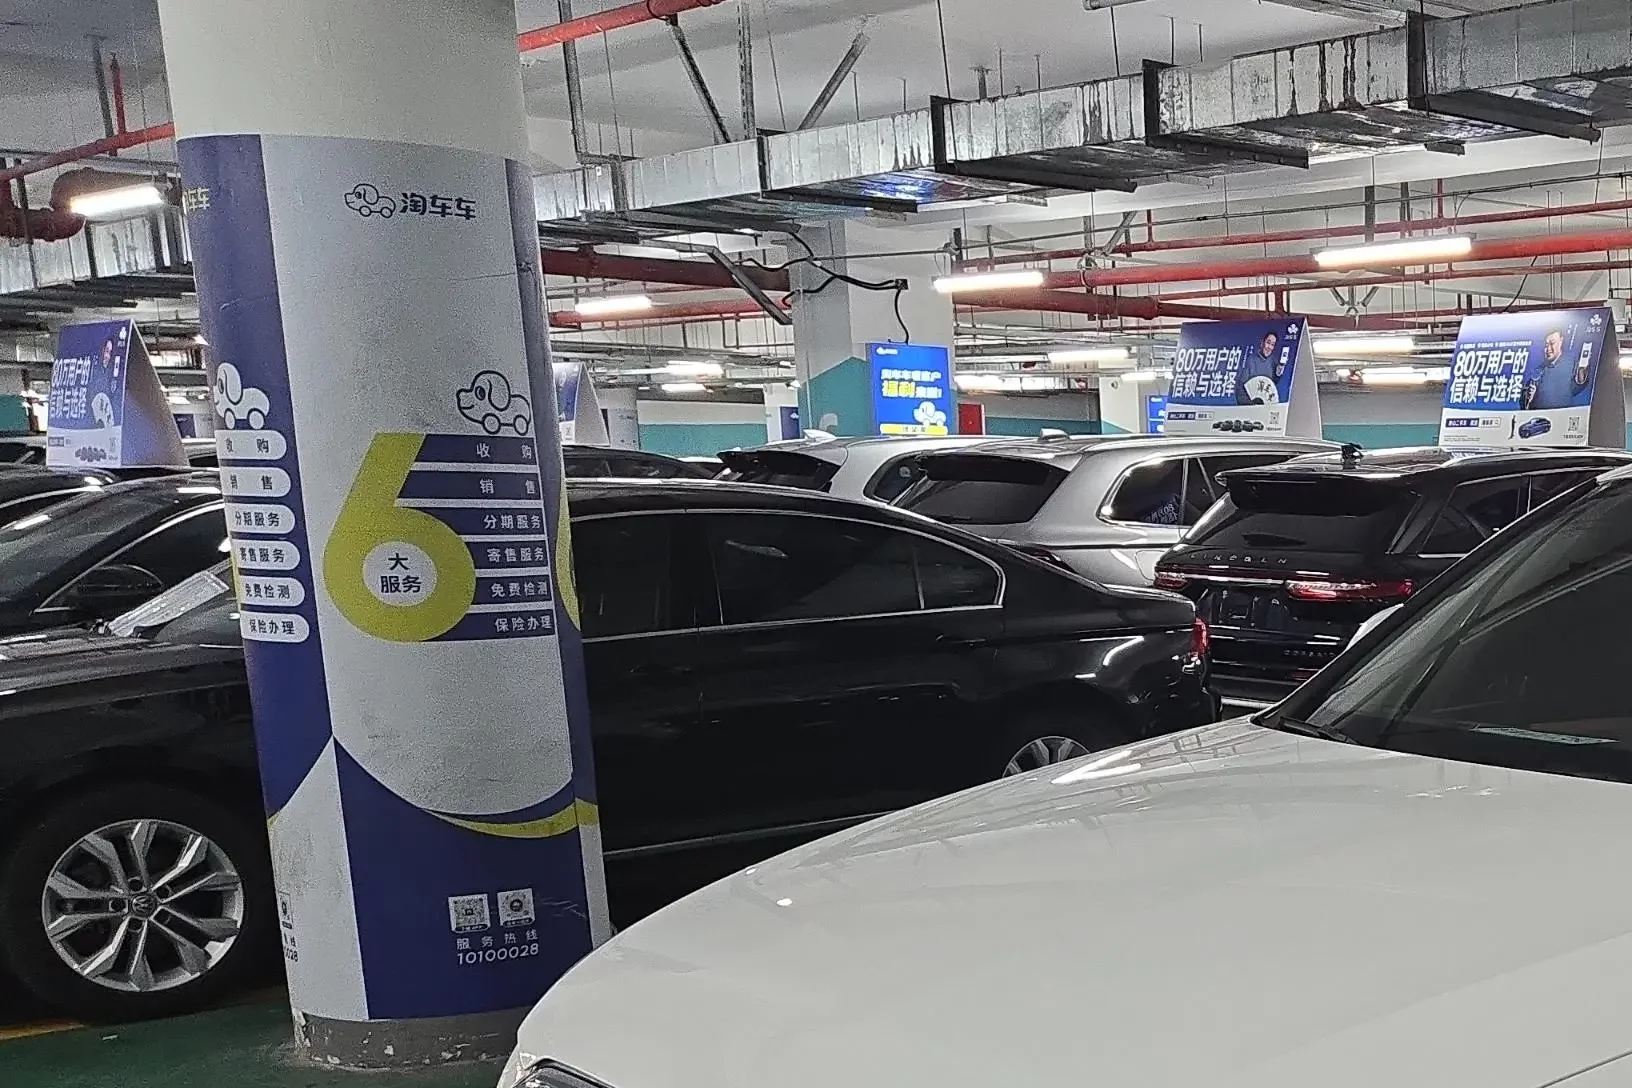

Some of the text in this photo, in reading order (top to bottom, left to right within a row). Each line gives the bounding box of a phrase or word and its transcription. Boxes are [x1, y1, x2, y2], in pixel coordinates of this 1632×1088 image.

[399, 192, 477, 220] 淘车车
[1176, 346, 1242, 372] 80万用户的
[1454, 348, 1529, 376] 80万用户的
[1172, 371, 1237, 398] 信赖与选择
[1450, 375, 1524, 404] 信赖与选择
[235, 511, 280, 528] 分期服务
[483, 514, 542, 531] 分期服务
[388, 552, 410, 572] 大
[487, 547, 545, 563] 寄售服务
[380, 574, 422, 594] 服务
[491, 581, 548, 598] 免费检测
[494, 614, 553, 633] 保险办理
[457, 929, 539, 950] 服务热线
[457, 943, 539, 965] 10100028
